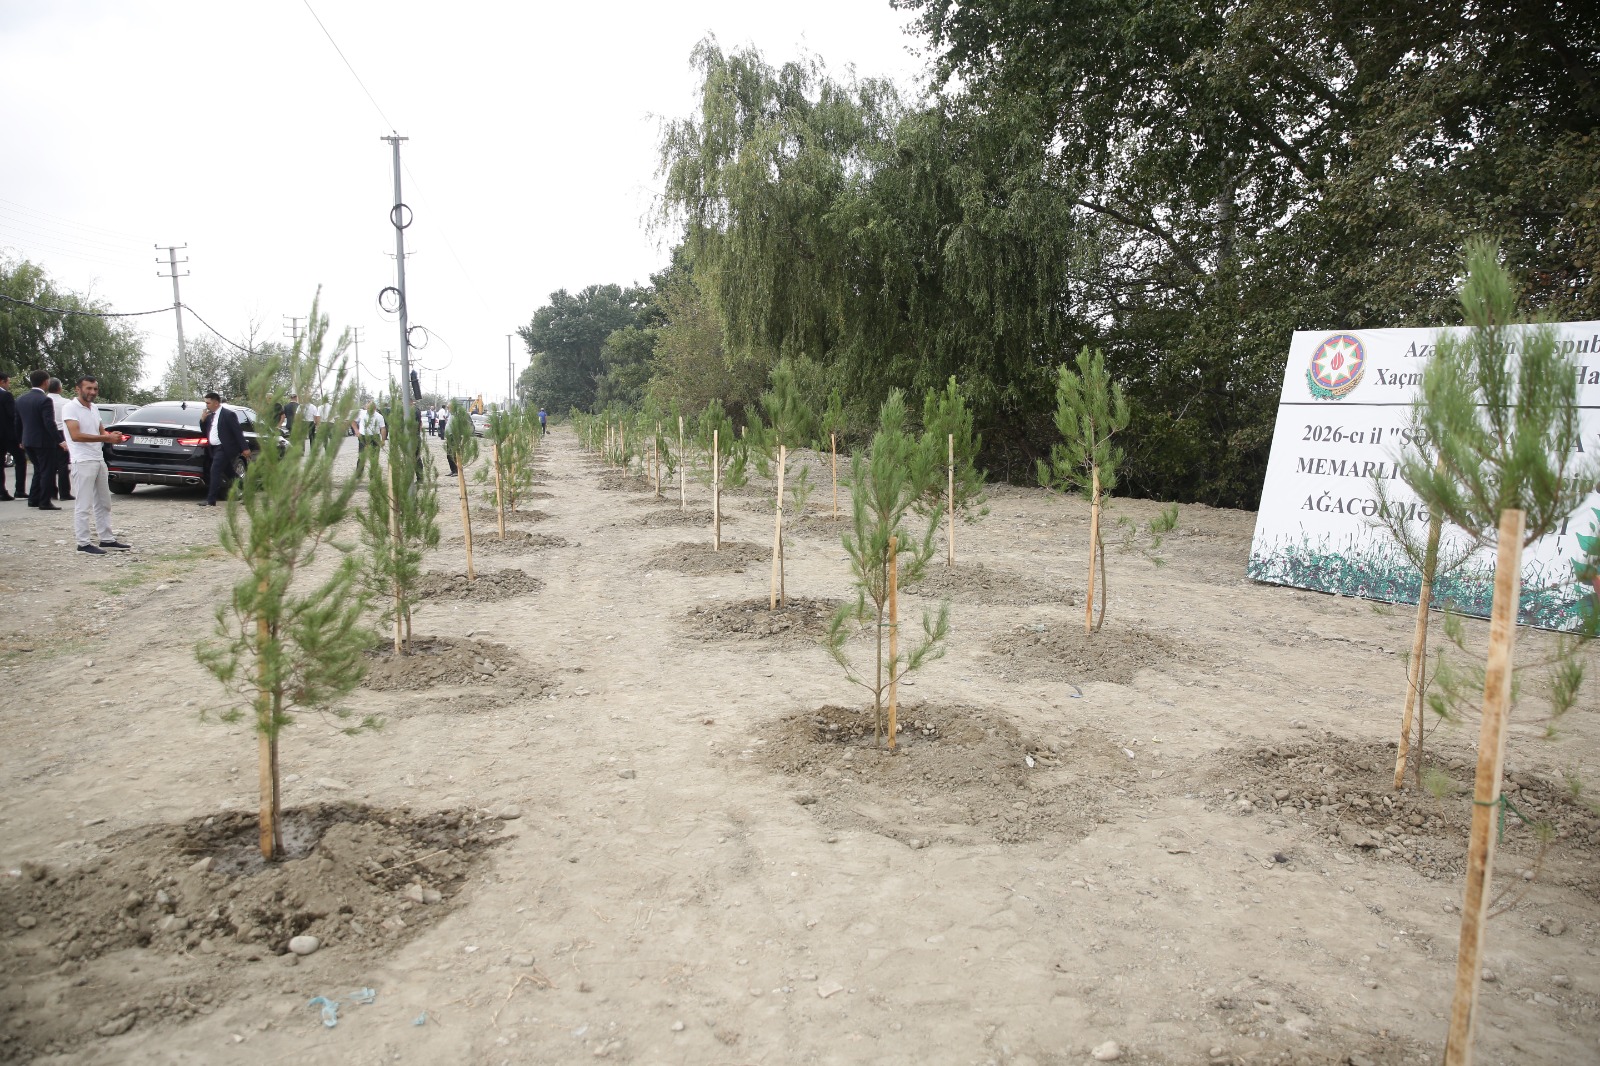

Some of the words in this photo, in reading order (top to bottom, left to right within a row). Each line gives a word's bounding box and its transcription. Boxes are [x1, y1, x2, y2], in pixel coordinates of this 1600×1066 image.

[1373, 368, 1440, 389] Xaçm
[1302, 424, 1364, 444] 2026-cı
[1369, 426, 1382, 445] il
